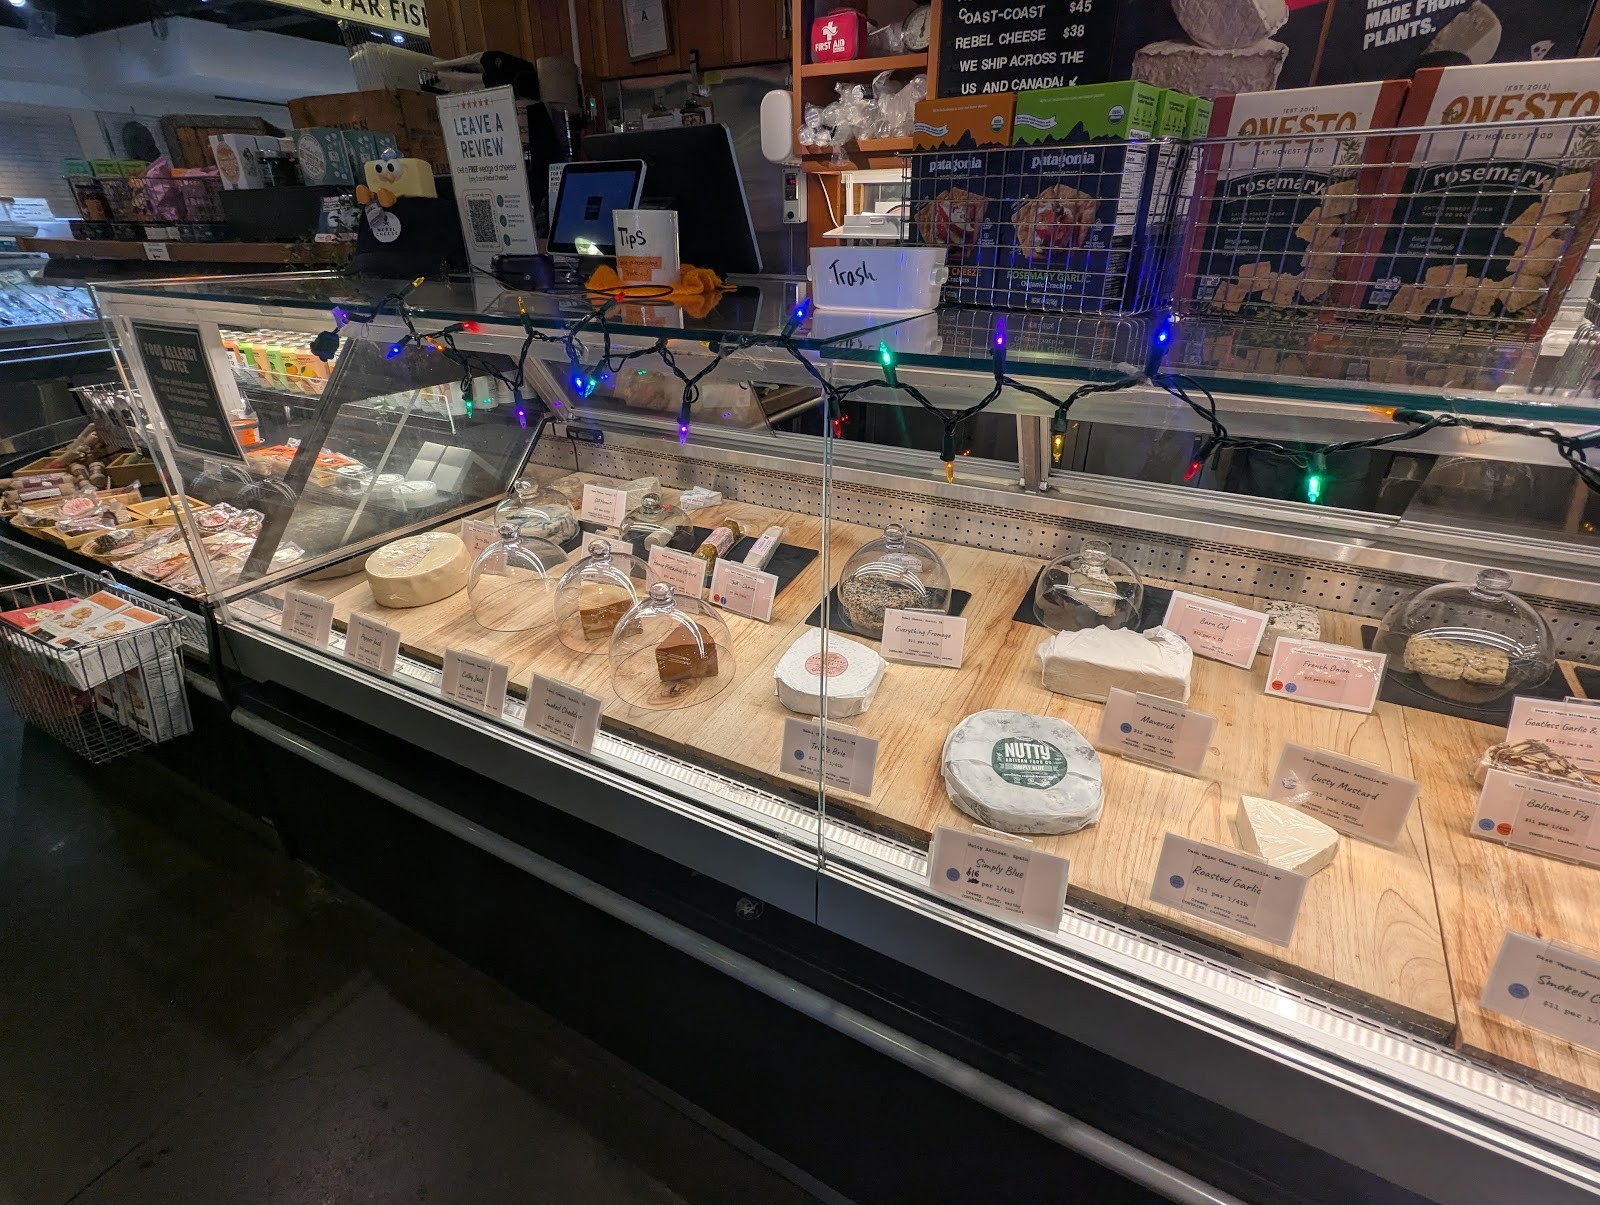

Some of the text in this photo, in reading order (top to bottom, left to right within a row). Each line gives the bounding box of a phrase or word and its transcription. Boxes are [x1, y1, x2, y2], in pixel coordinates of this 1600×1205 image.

[959, 0, 1092, 24] COAST-COAST $45
[1365, 2, 1412, 30] MADE
[956, 25, 1085, 49] REBEL CHEESE $38
[1363, 17, 1436, 50] PLANTS.
[815, 41, 831, 52] FIRST
[833, 39, 845, 47] AID
[960, 51, 1084, 72] WE SHIP ACROSS THE
[961, 76, 1063, 94] US AND CANADA!
[1441, 90, 1599, 125] ONESTO
[454, 113, 504, 136] LEAVE A
[1237, 112, 1357, 147] ONESTO
[461, 138, 504, 158] REVIEW
[929, 157, 981, 172] patagonia
[1031, 152, 1095, 169] patagonia
[1237, 177, 1325, 196] rosemary
[1434, 167, 1550, 188] rosemary
[829, 259, 877, 286] Trash
[1056, 272, 1091, 283] GARLIC
[1200, 618, 1215, 626] Barn
[895, 626, 951, 639] Everything Fromage
[1303, 660, 1350, 674] French Onion
[1140, 716, 1175, 730] Maverick
[1525, 718, 1598, 735] Goatless Garlic &
[832, 748, 846, 757] Brie
[1005, 743, 1050, 760] NUTTY
[1311, 773, 1379, 801] Lusty Mustard
[1526, 800, 1589, 821] Balsamic Fig
[1013, 854, 1029, 862] Spain
[976, 858, 1024, 879] Simply Blue
[996, 885, 1015, 894] 1/4lb
[1192, 865, 1261, 895] Roasted Garlic
[1211, 891, 1224, 899] per
[1227, 897, 1249, 907] 1/4lb
[1537, 975, 1600, 1004] Smoked C
[1564, 1009, 1582, 1018] per
